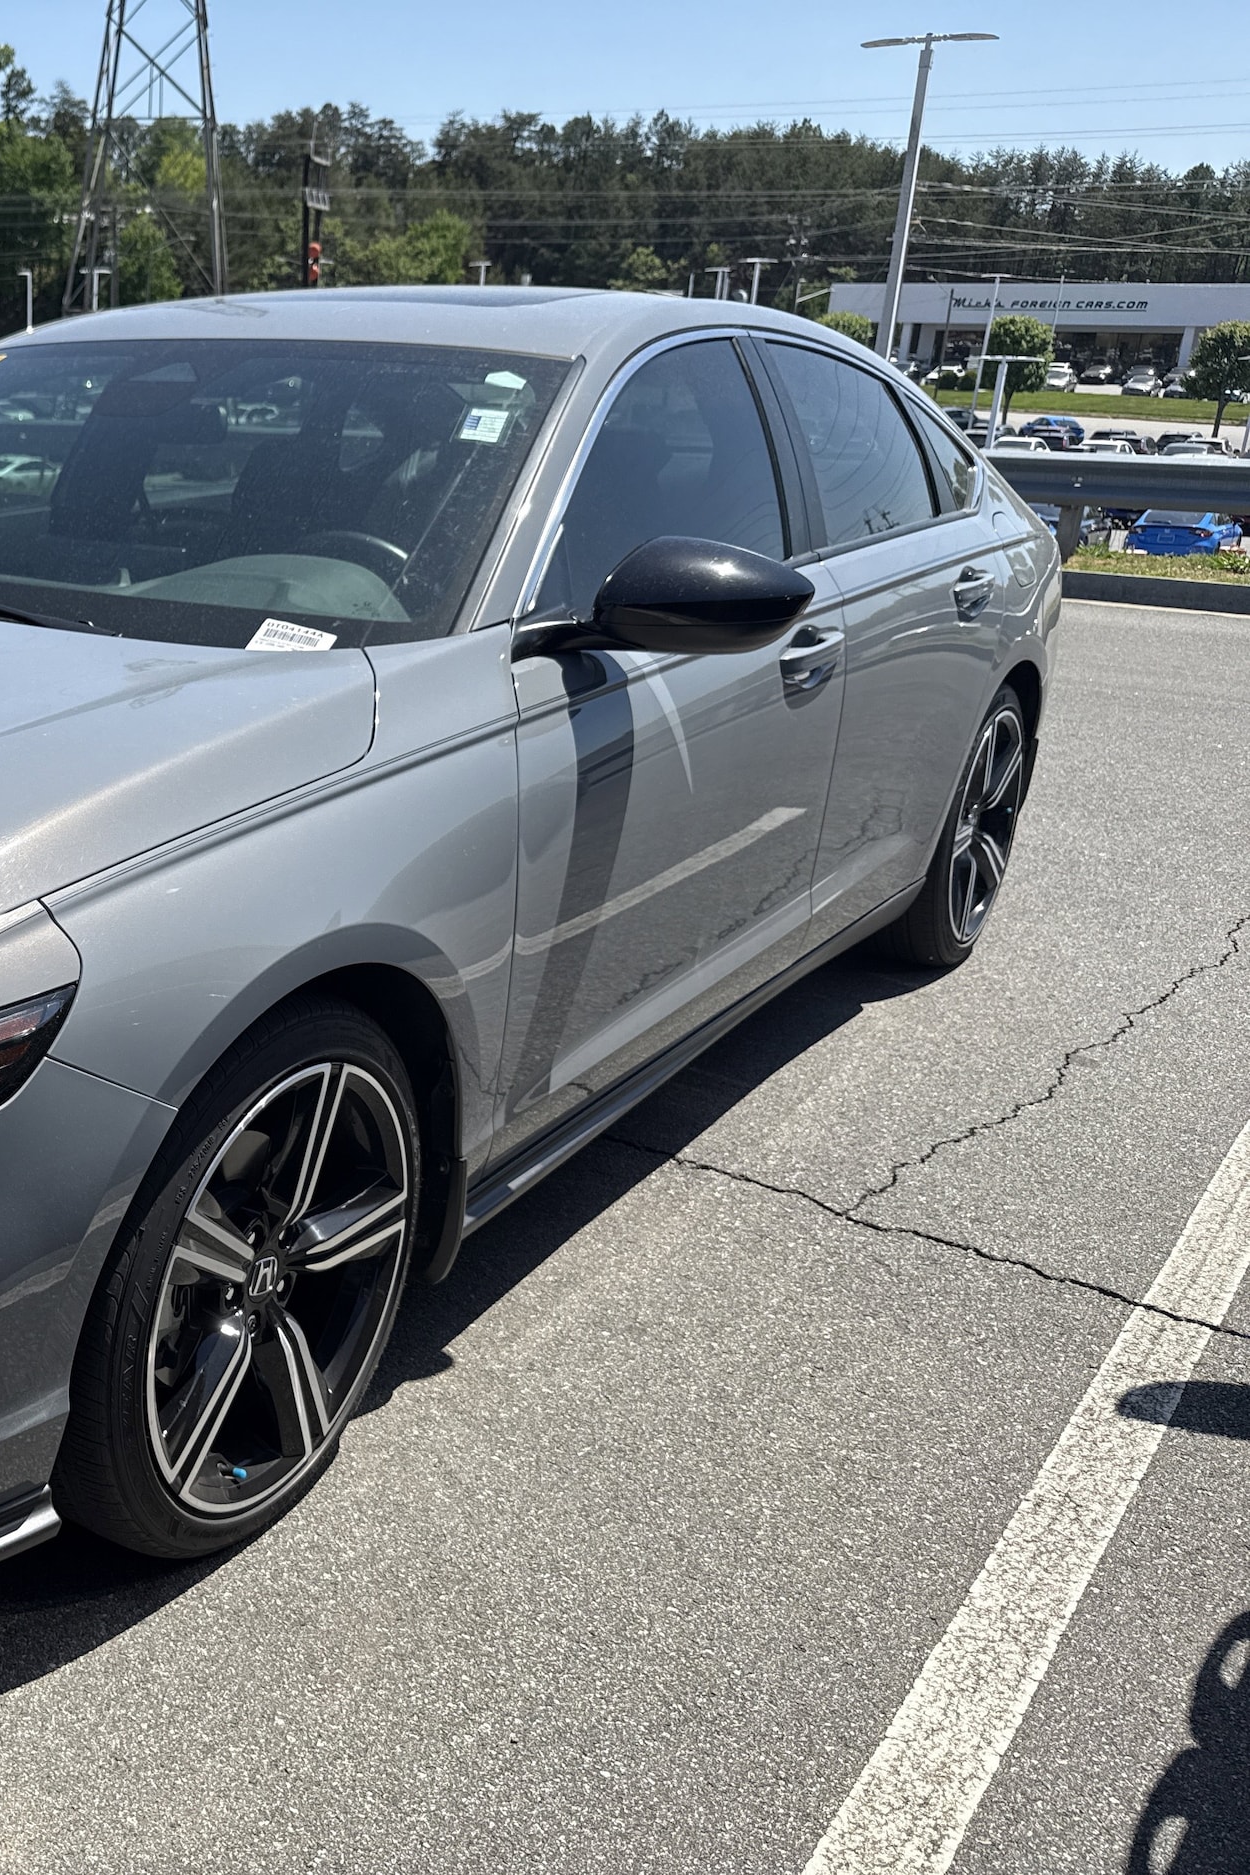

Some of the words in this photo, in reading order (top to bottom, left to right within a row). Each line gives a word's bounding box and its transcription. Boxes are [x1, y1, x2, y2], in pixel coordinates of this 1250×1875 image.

[952, 297, 1005, 309] Mick's
[1010, 300, 1071, 309] FOREIGN
[1076, 301, 1148, 310] CARS.COM
